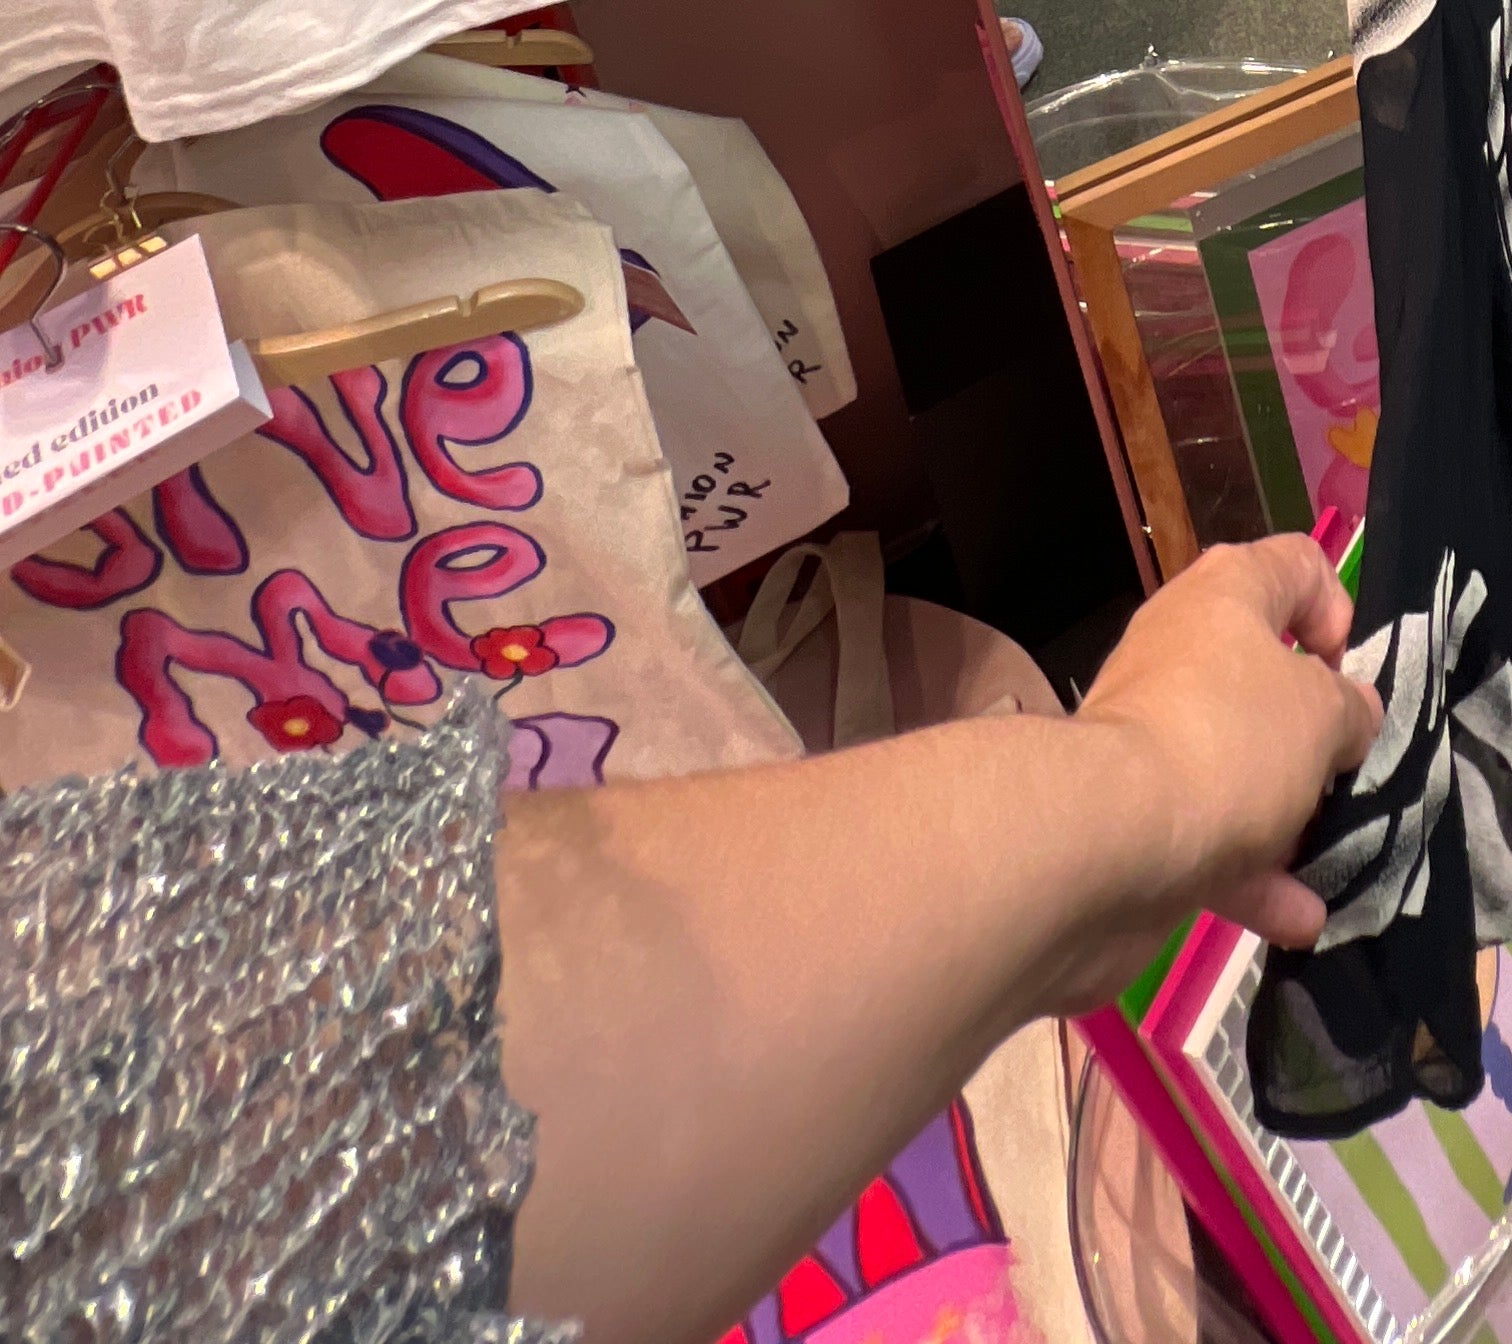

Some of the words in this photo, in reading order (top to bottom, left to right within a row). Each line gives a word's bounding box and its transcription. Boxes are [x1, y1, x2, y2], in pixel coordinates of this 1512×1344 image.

[70, 294, 147, 350] PWR
[0, 441, 42, 484] ed
[50, 383, 159, 452] edition
[2, 388, 202, 516] D-PAINTED
[684, 479, 771, 552] PWR
